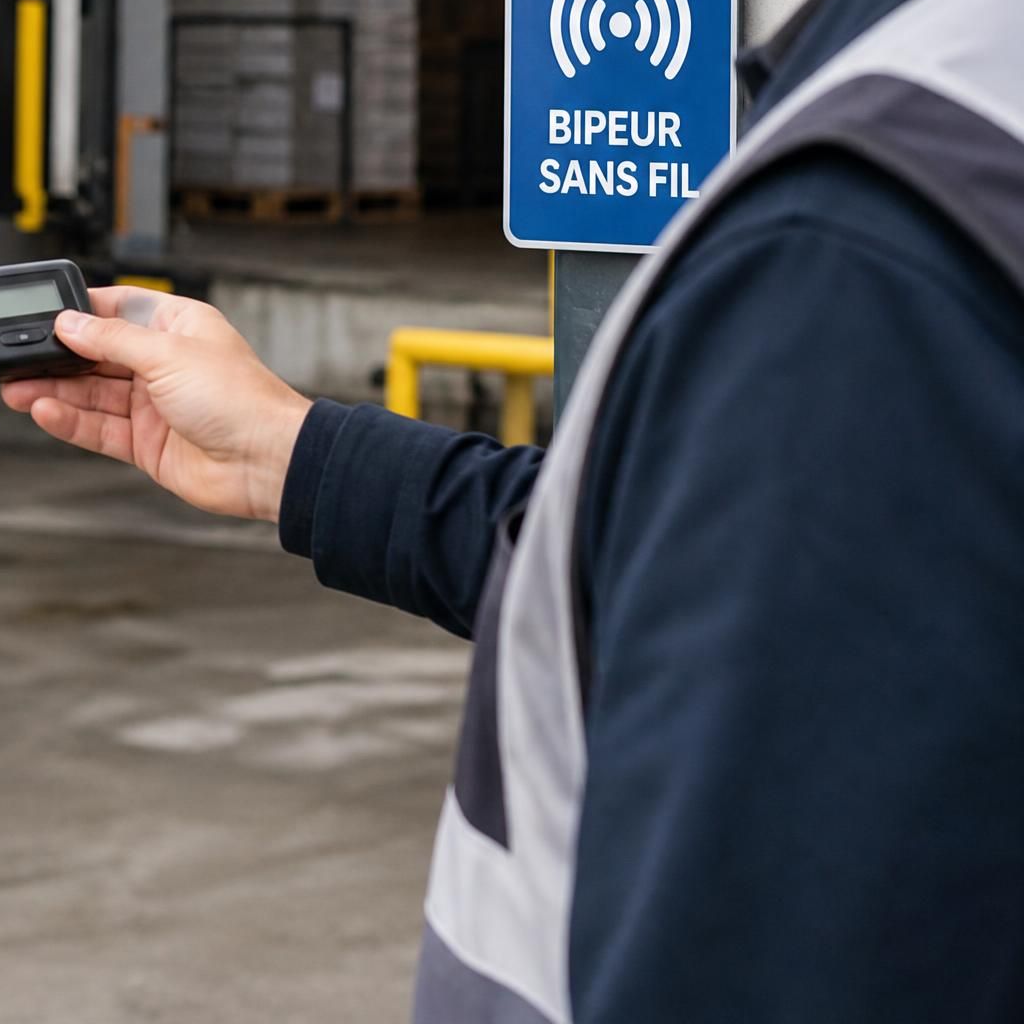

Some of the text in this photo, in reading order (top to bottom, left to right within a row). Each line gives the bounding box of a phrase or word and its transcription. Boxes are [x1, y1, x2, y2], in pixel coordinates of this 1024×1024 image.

[549, 109, 682, 147] BIPEUR
[539, 158, 701, 199] SANS FIL
